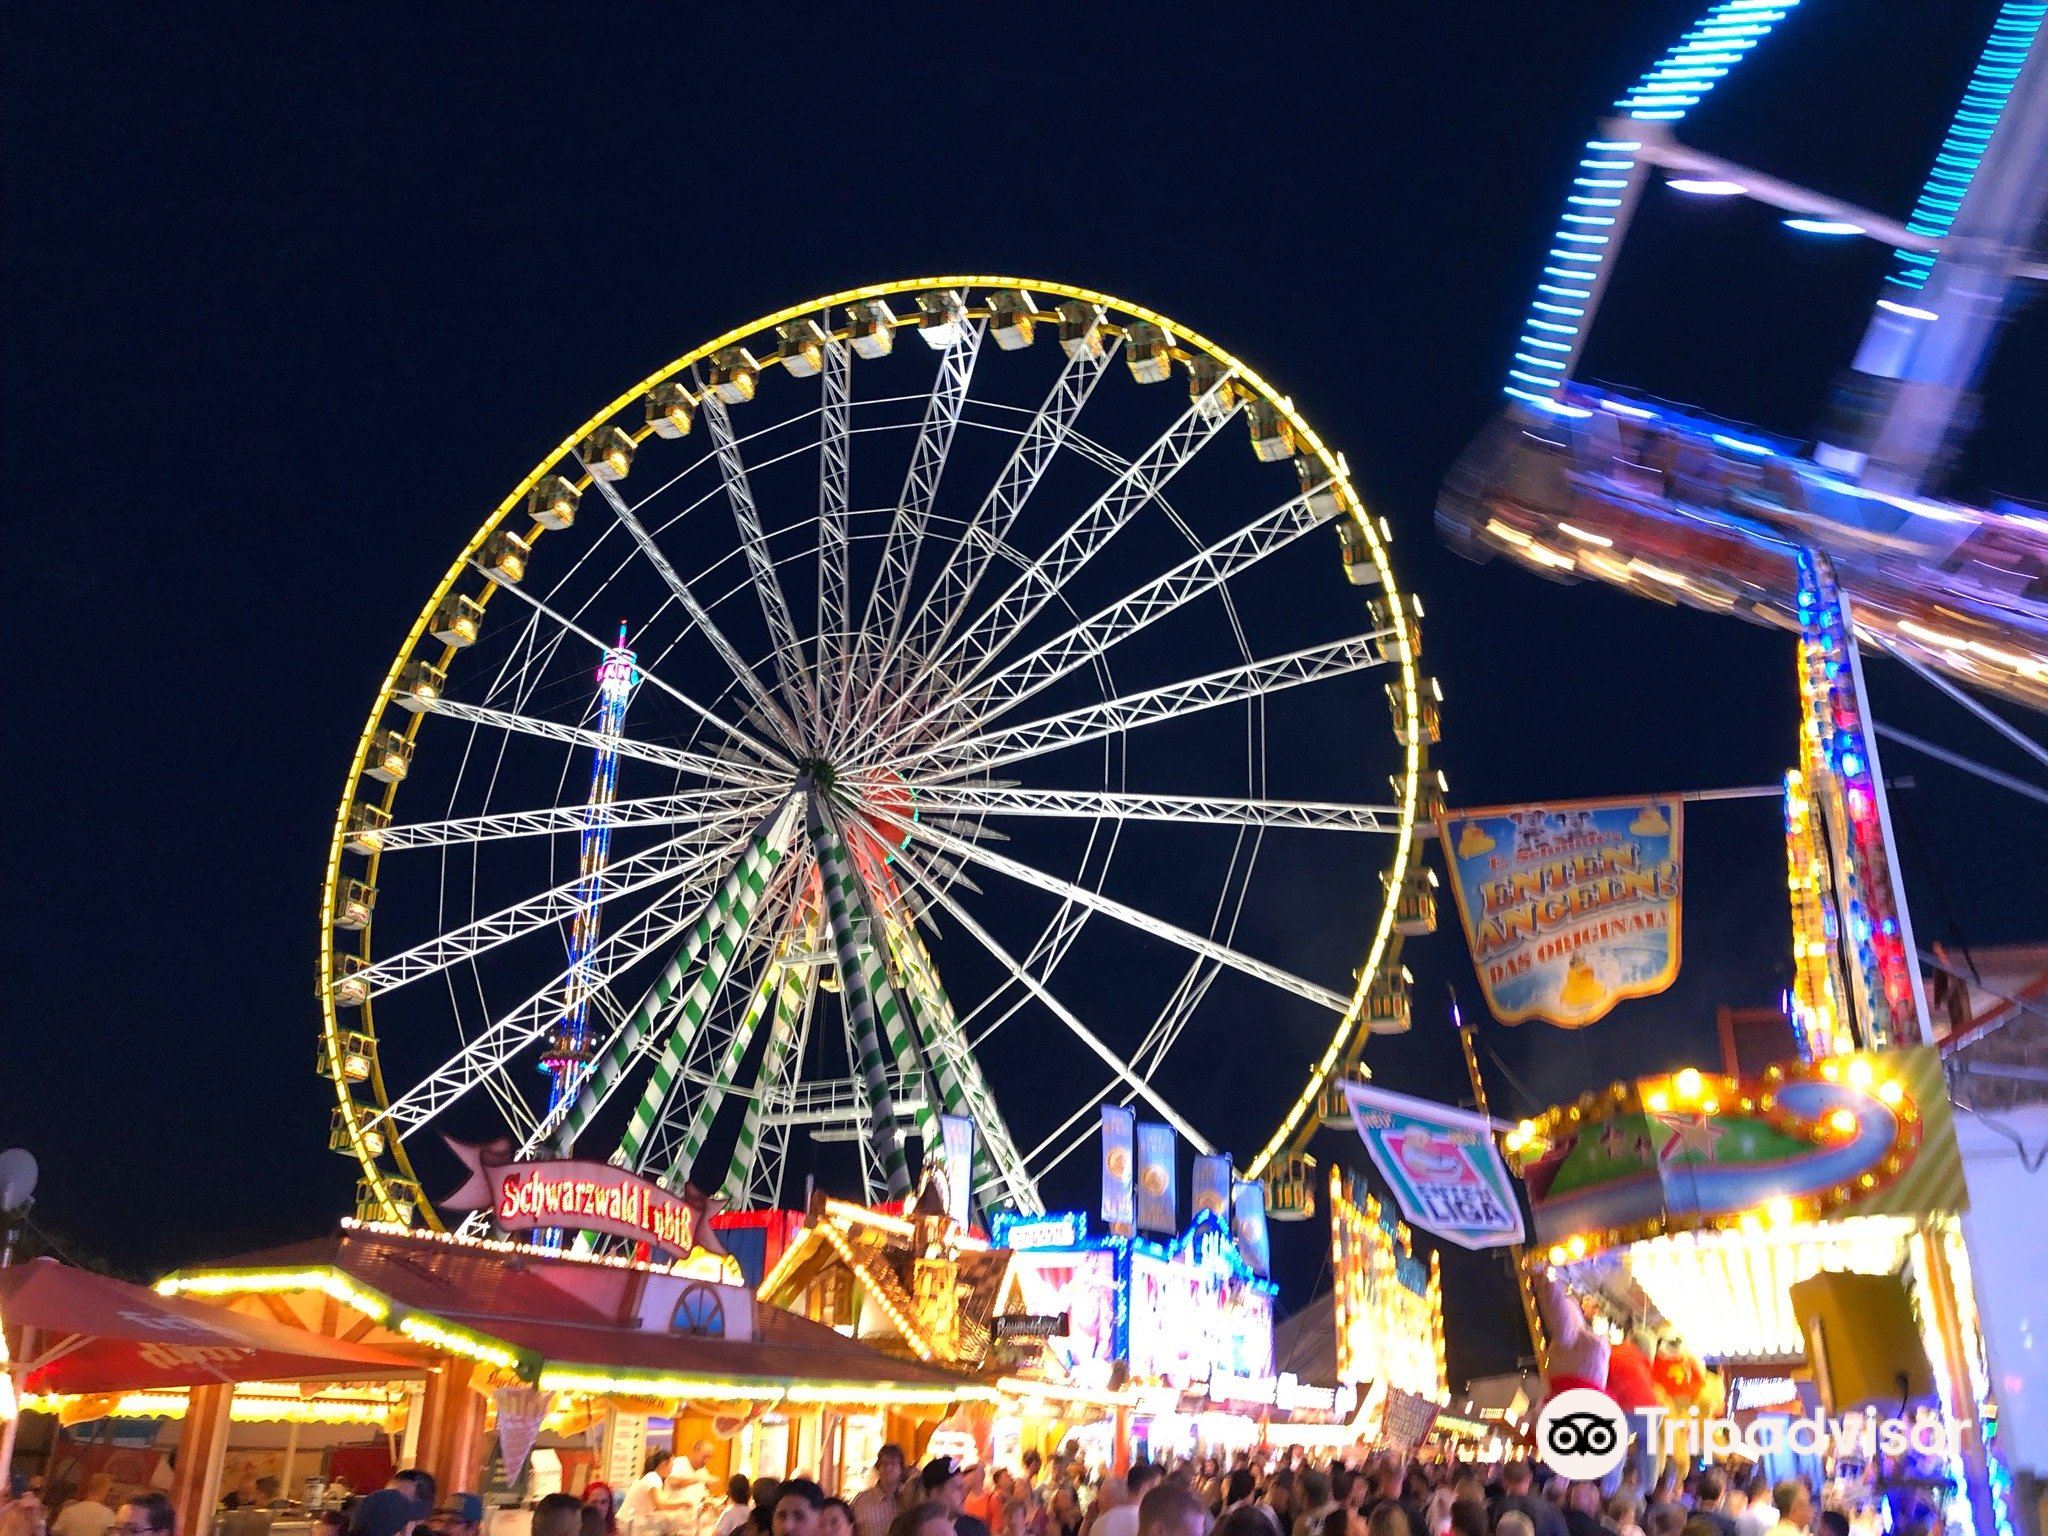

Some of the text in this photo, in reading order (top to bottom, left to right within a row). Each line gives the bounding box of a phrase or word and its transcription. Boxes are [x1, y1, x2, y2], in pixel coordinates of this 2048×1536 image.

[1480, 843, 1640, 918] ENTEN
[1488, 951, 1532, 985] DAS
[501, 1170, 639, 1227] Schwarzwald
